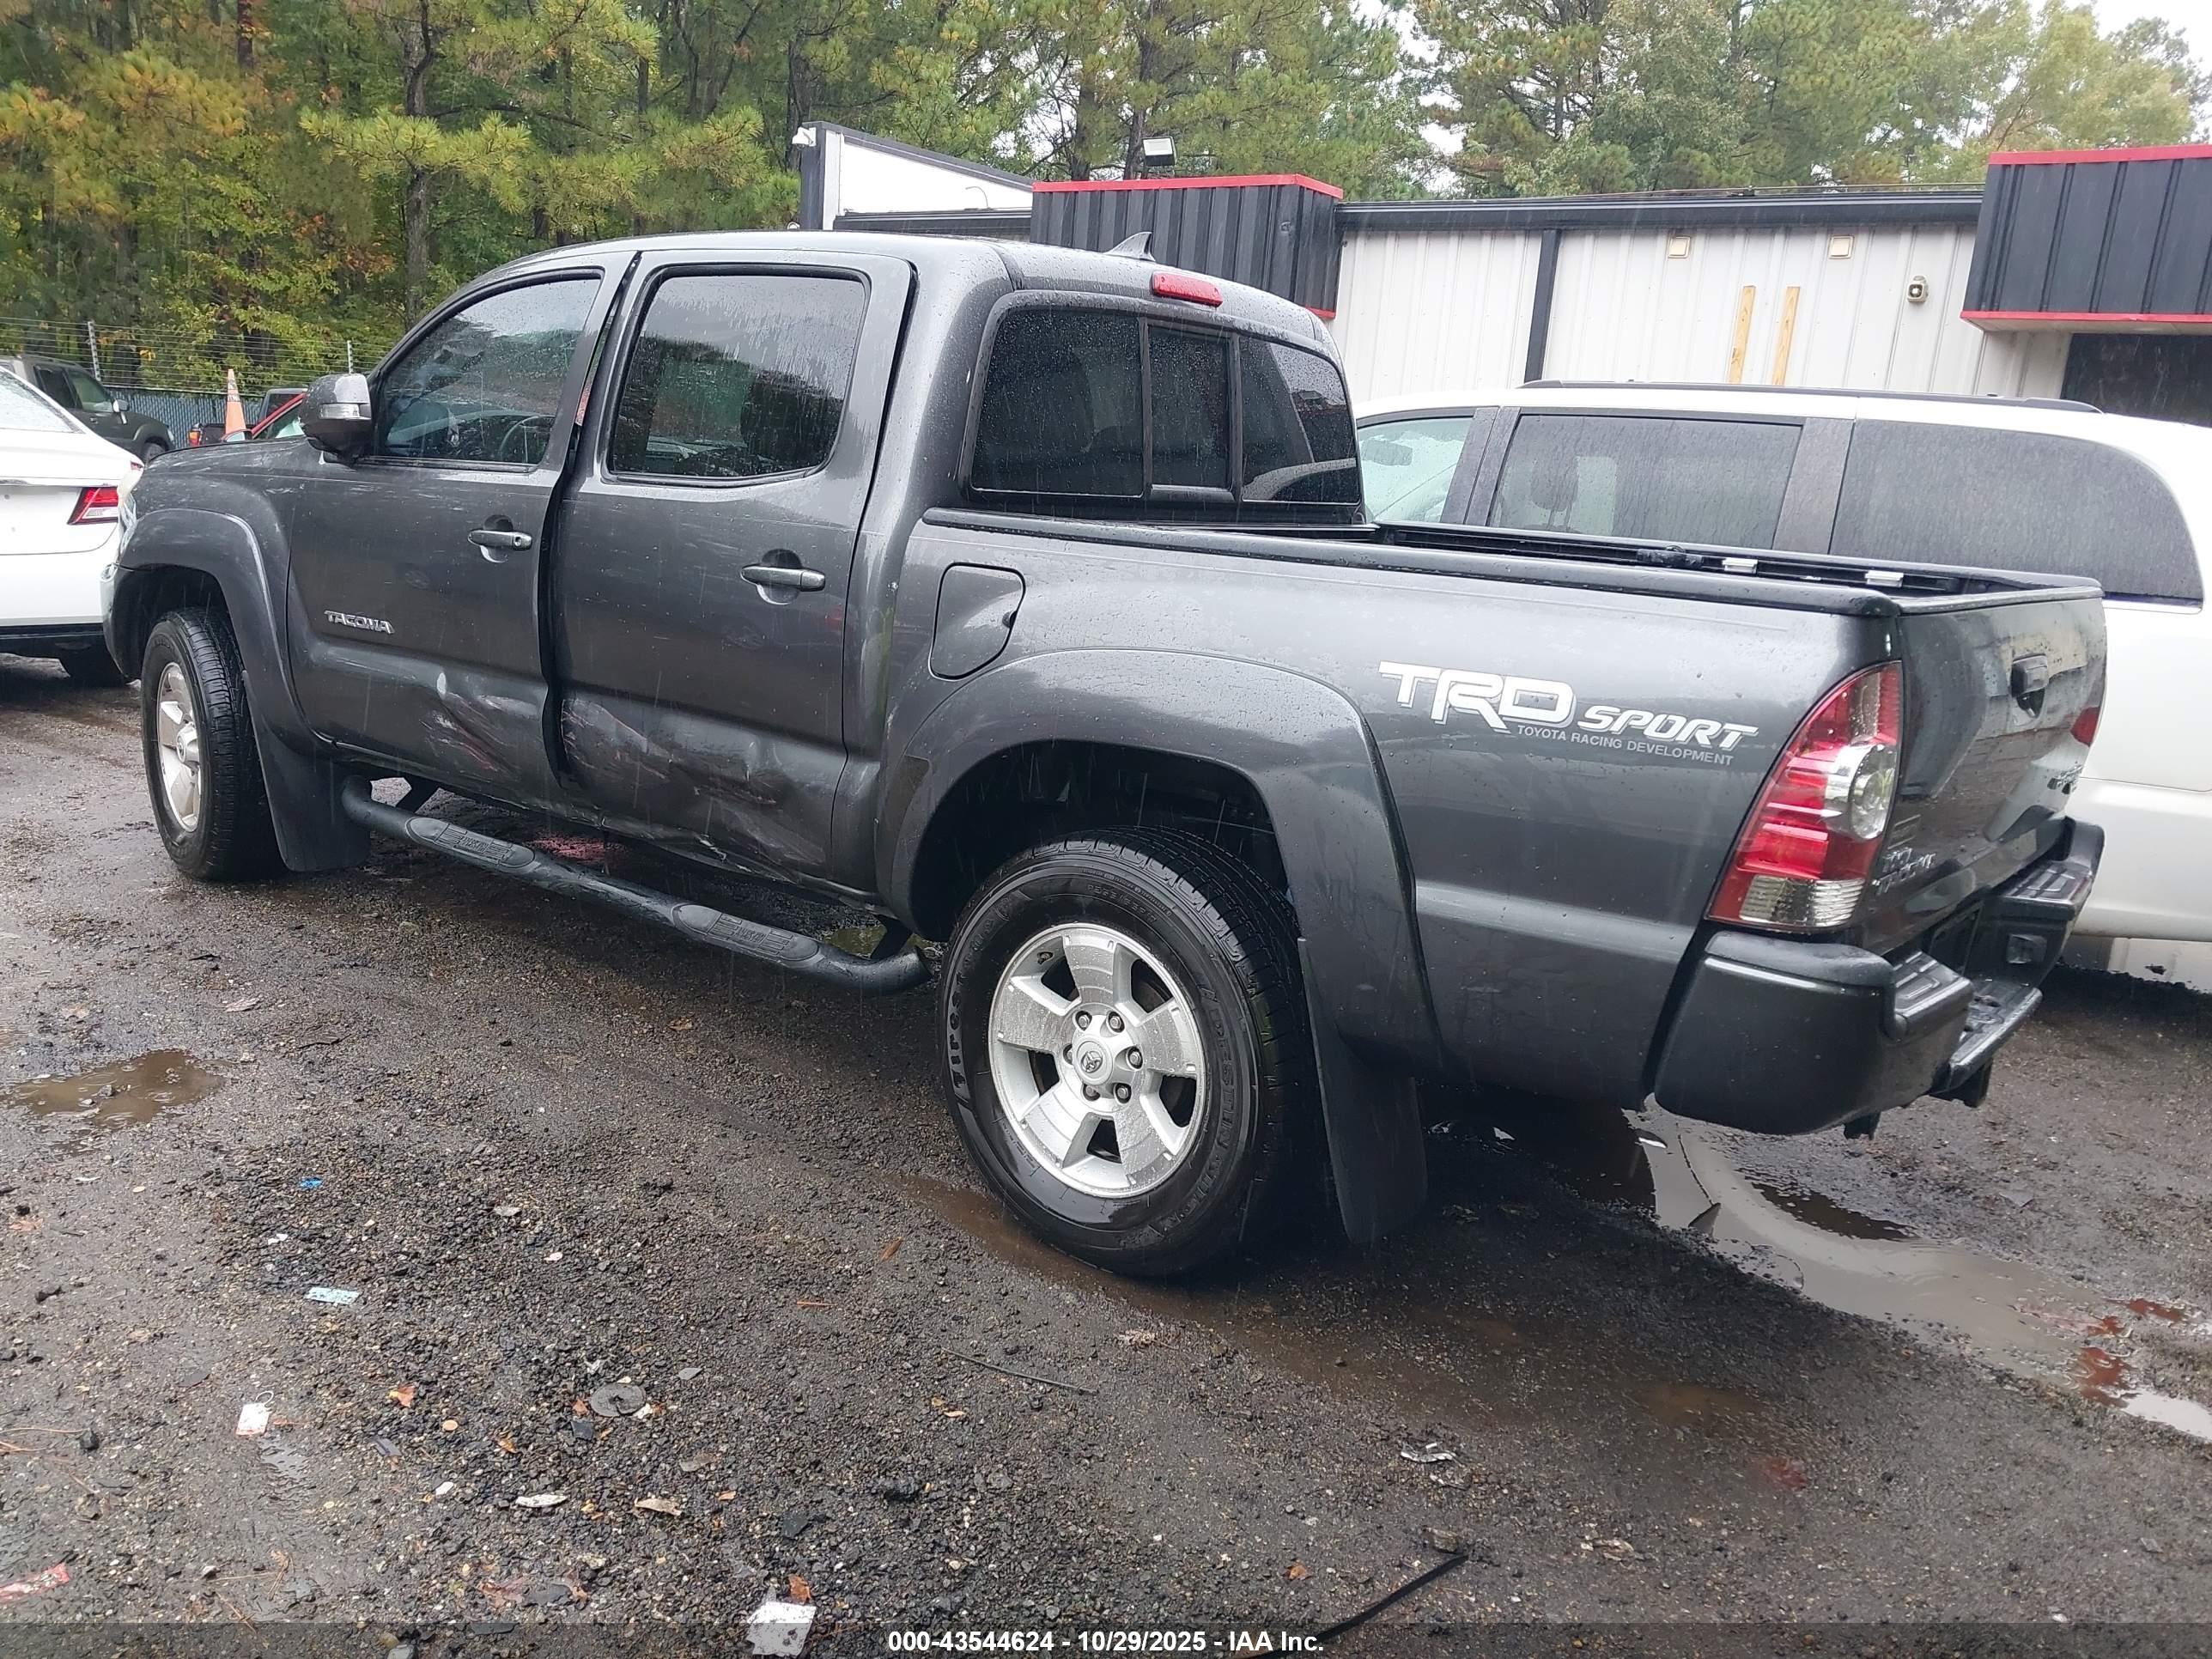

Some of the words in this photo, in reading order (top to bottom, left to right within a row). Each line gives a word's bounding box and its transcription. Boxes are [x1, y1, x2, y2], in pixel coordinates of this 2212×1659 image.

[324, 610, 395, 635] TACOMA
[1377, 660, 1577, 734] TRD
[1577, 704, 1759, 751] SPORT
[1517, 725, 1567, 743] TOYOTA
[1571, 731, 1623, 750] RACING
[1626, 739, 1735, 767] DEVELOPMENT
